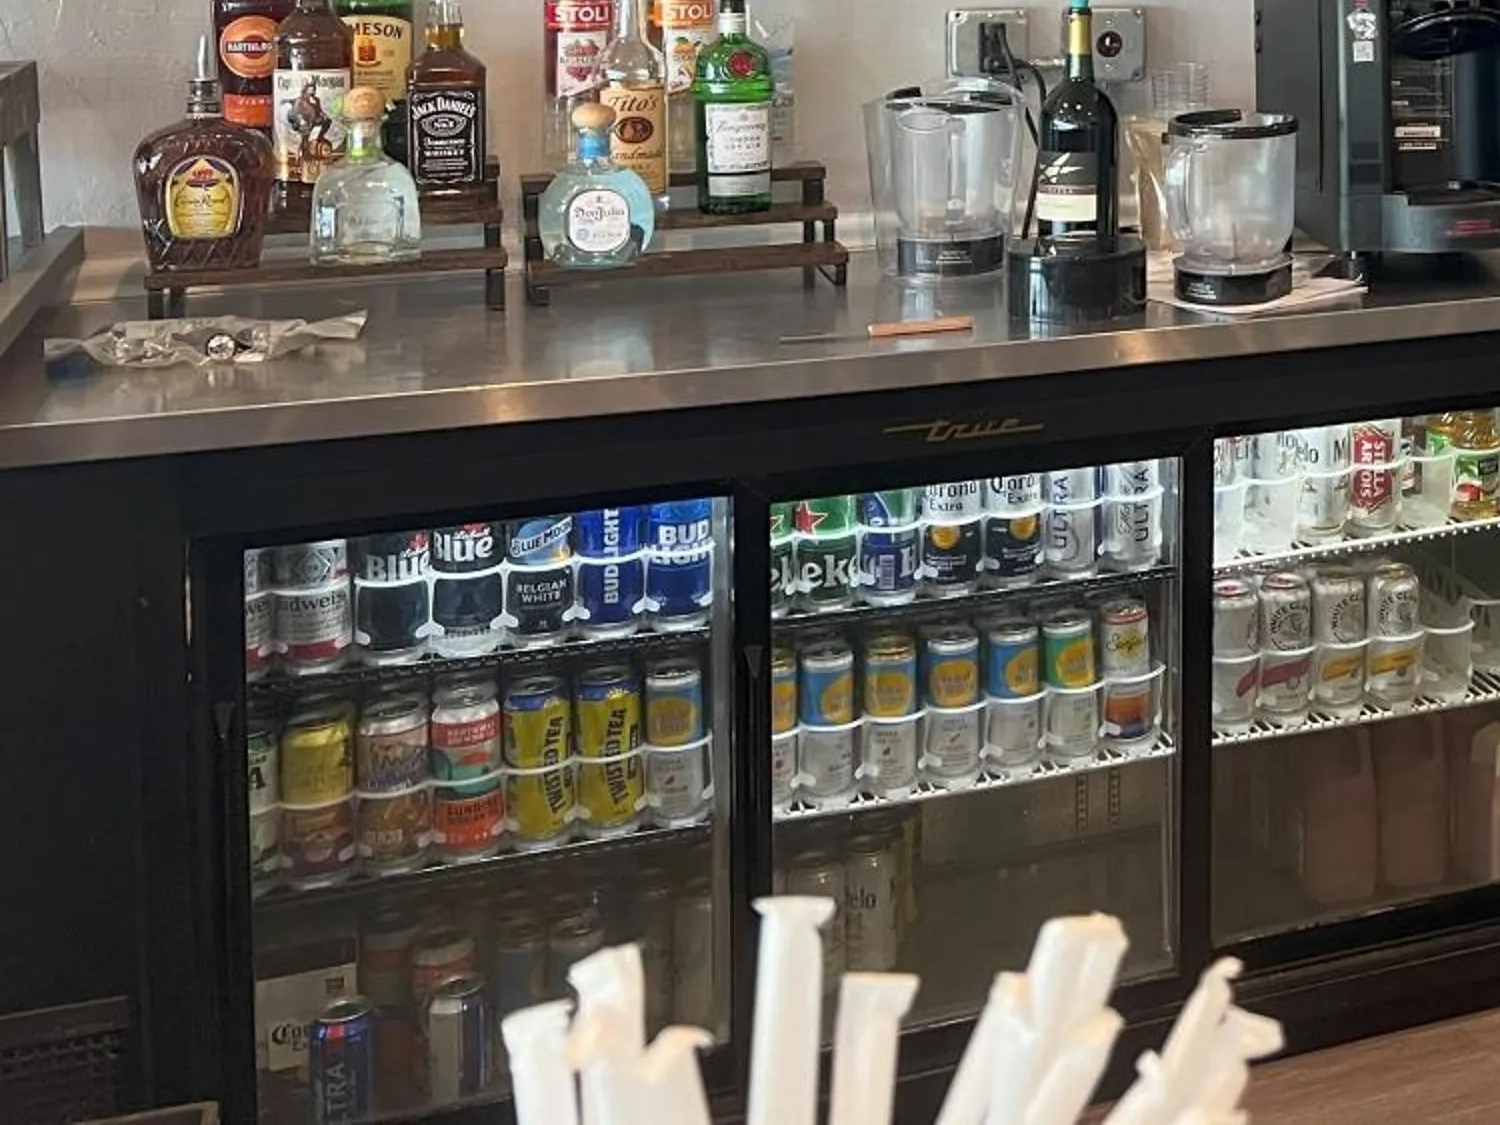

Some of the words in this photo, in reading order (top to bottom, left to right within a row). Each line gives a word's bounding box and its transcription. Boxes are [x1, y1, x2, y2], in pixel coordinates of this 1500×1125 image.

[555, 5, 609, 22] STOLI
[353, 22, 403, 39] MESON
[412, 100, 437, 120] JACK
[608, 93, 658, 113] Tito's
[603, 508, 619, 559] LIGHT
[659, 518, 710, 546] BUD
[433, 530, 493, 563] Blue
[515, 578, 567, 594] BELGIAN
[603, 564, 619, 604] BUD
[521, 591, 561, 604] WHITE
